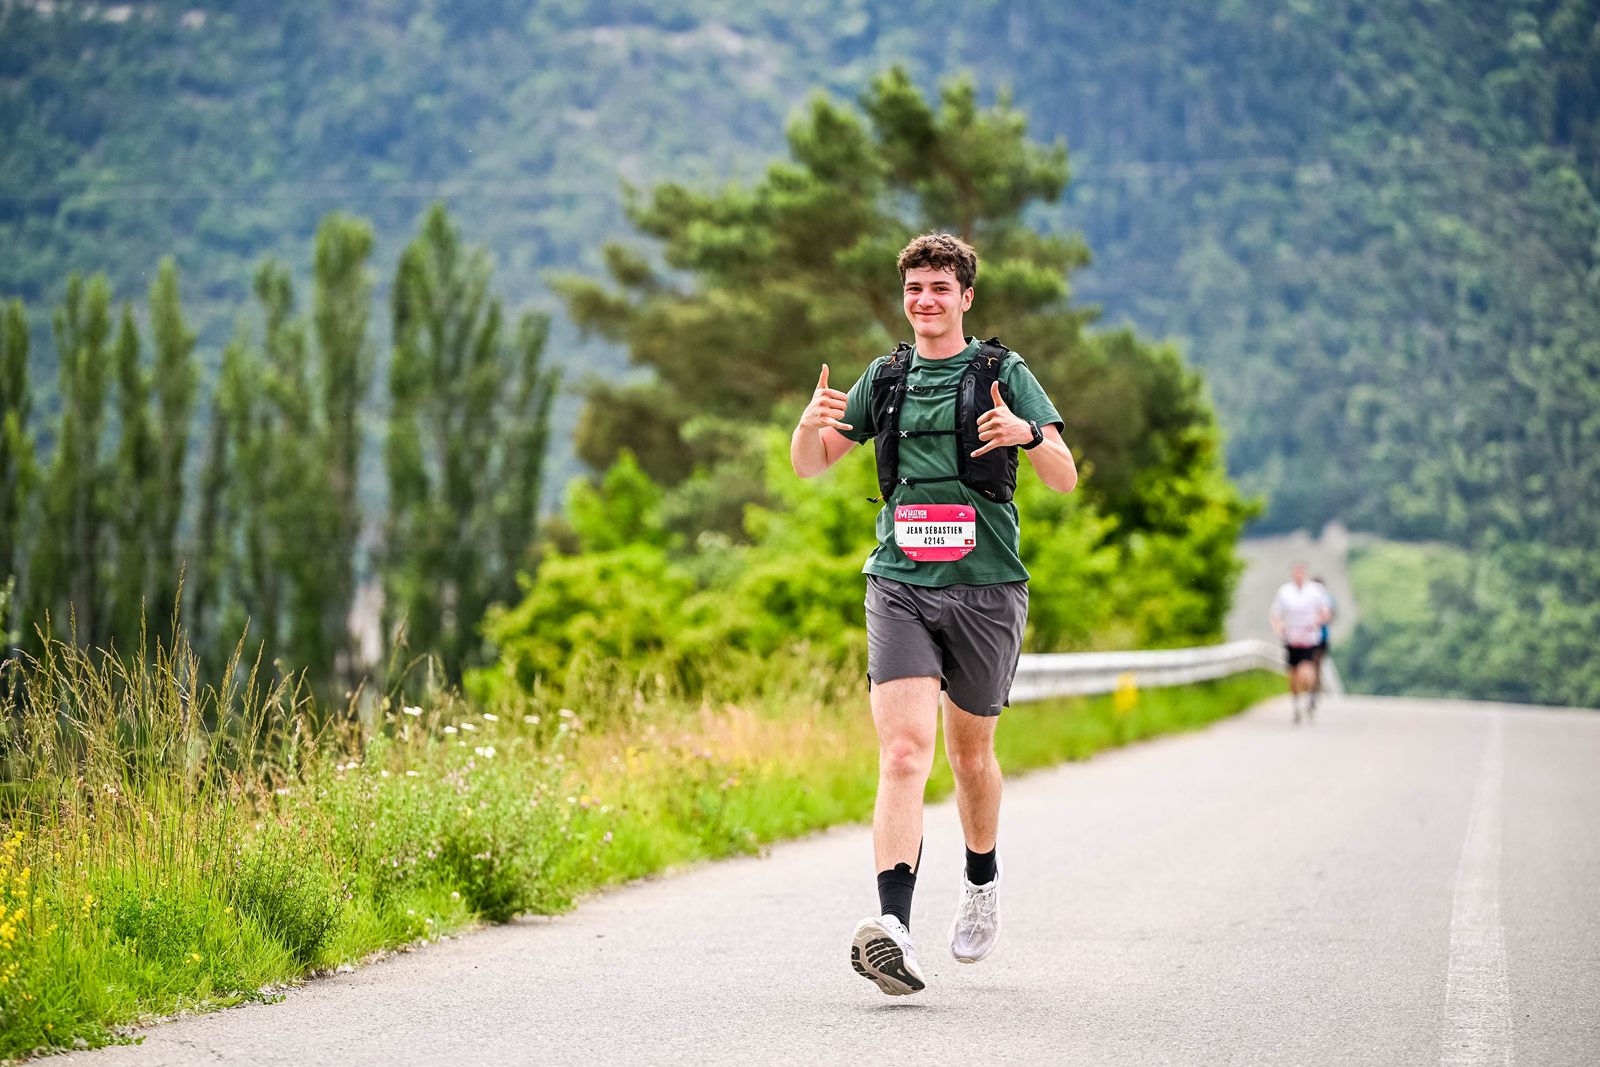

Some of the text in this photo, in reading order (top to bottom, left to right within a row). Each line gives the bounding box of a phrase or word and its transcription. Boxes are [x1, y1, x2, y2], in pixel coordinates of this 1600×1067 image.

[906, 526, 923, 535] JEAN
[925, 525, 963, 535] SÉBASTIEN
[924, 537, 945, 545] 42145
